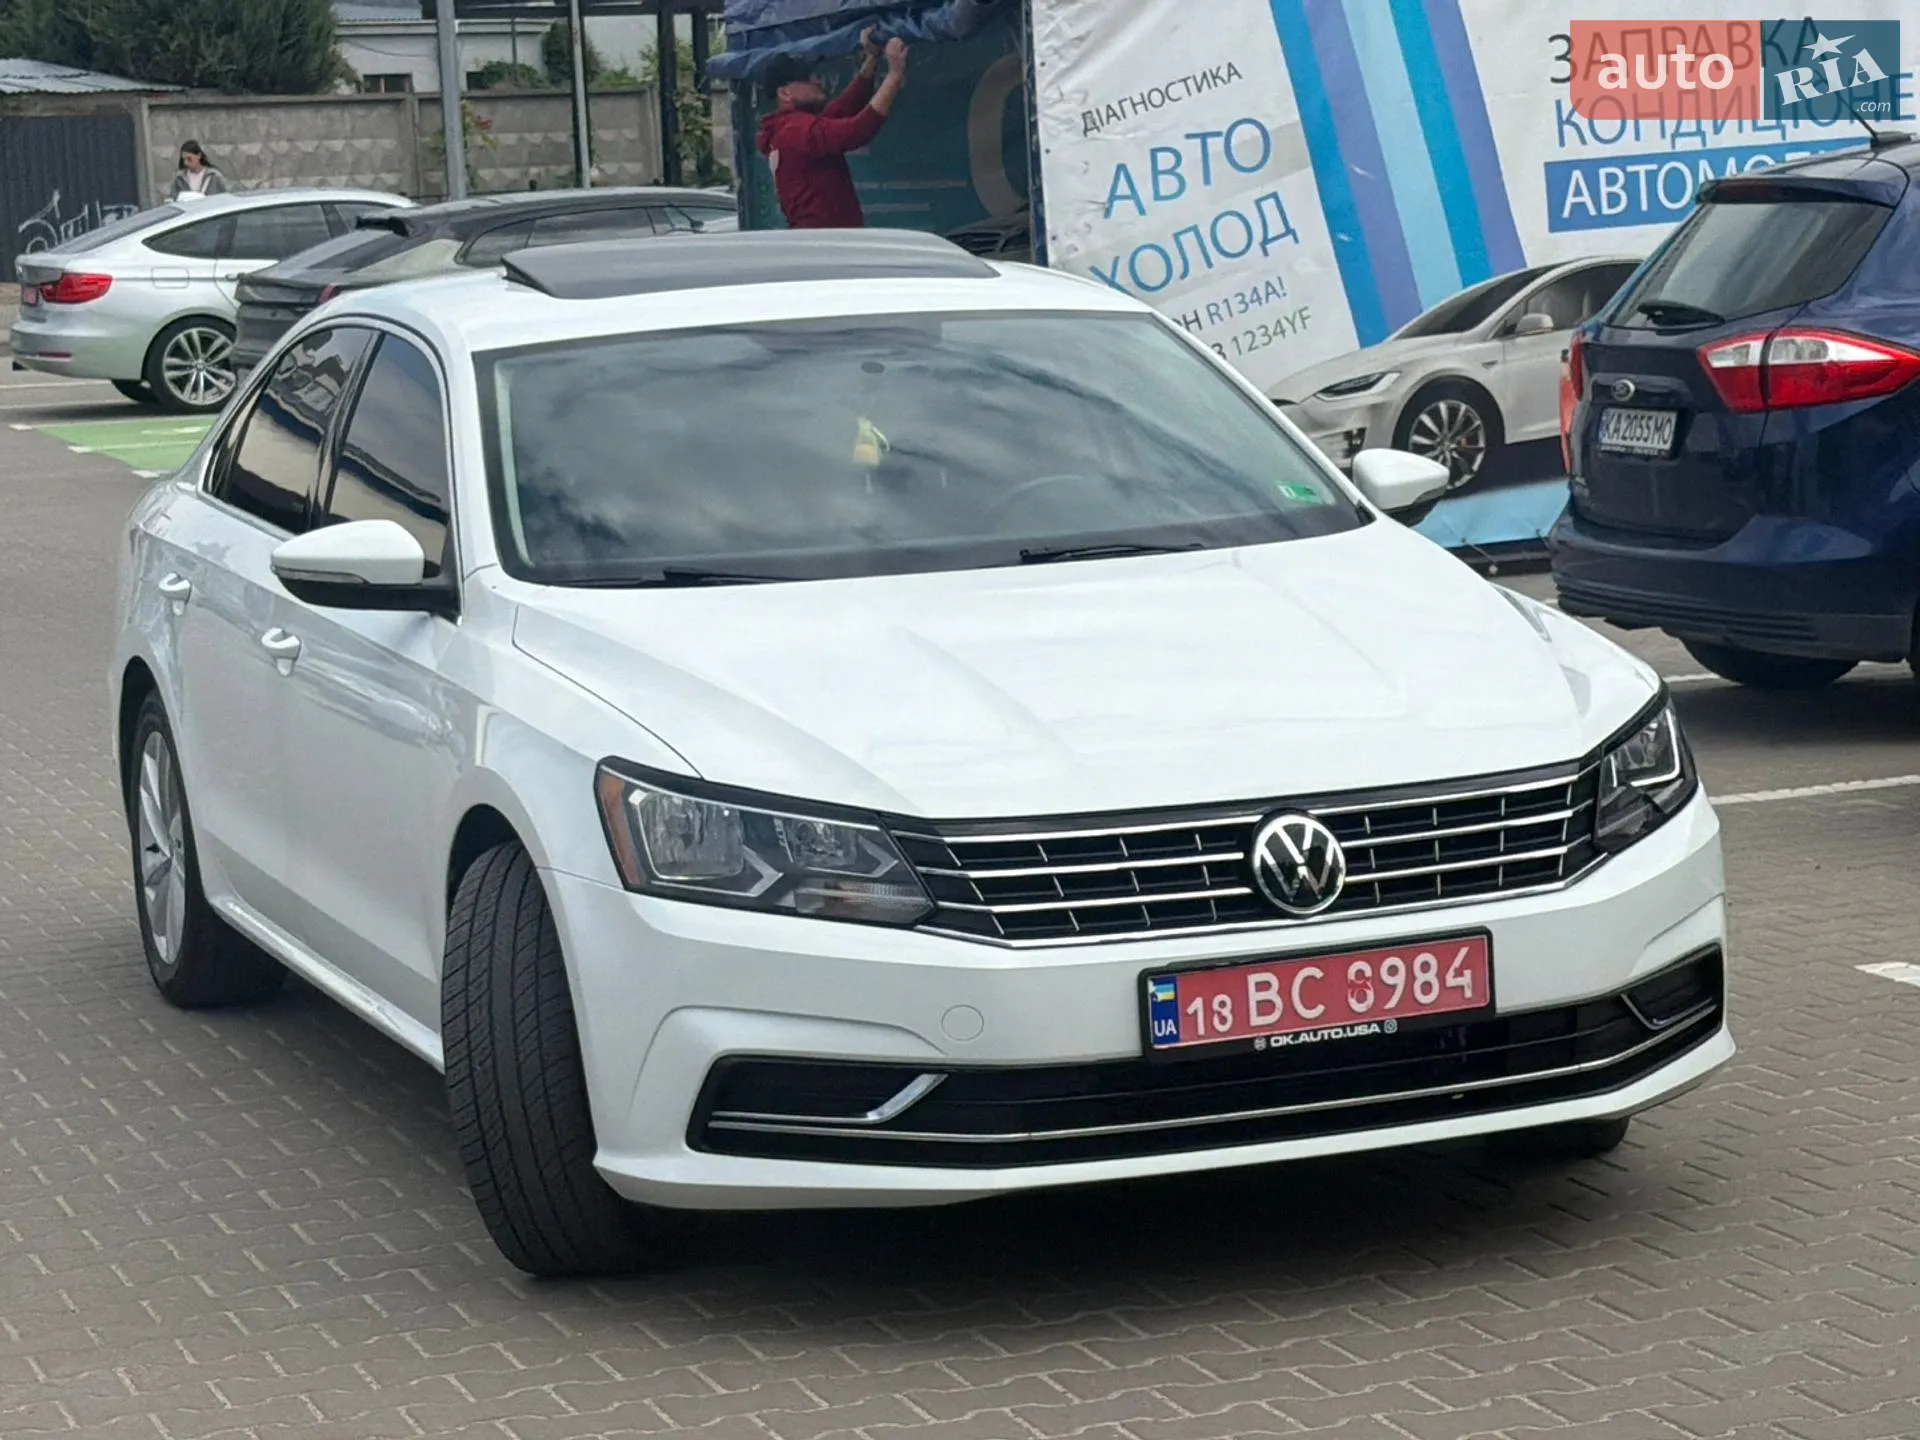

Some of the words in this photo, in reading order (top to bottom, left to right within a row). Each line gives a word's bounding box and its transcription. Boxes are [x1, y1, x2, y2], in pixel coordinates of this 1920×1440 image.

[1548, 16, 1829, 84] ЗАПРАВКА
[1081, 61, 1243, 138] ДІАГНОСТИКА
[1103, 117, 1272, 220] АВТО
[1088, 191, 1300, 294] ХОЛОД
[1206, 276, 1288, 326] R134A!
[1231, 306, 1312, 357] 1234YF
[1153, 1019, 1178, 1037] UA
[1187, 994, 1234, 1036] 18
[1247, 966, 1326, 1027] BC
[1270, 1023, 1381, 1047] OK.AUTO.USA
